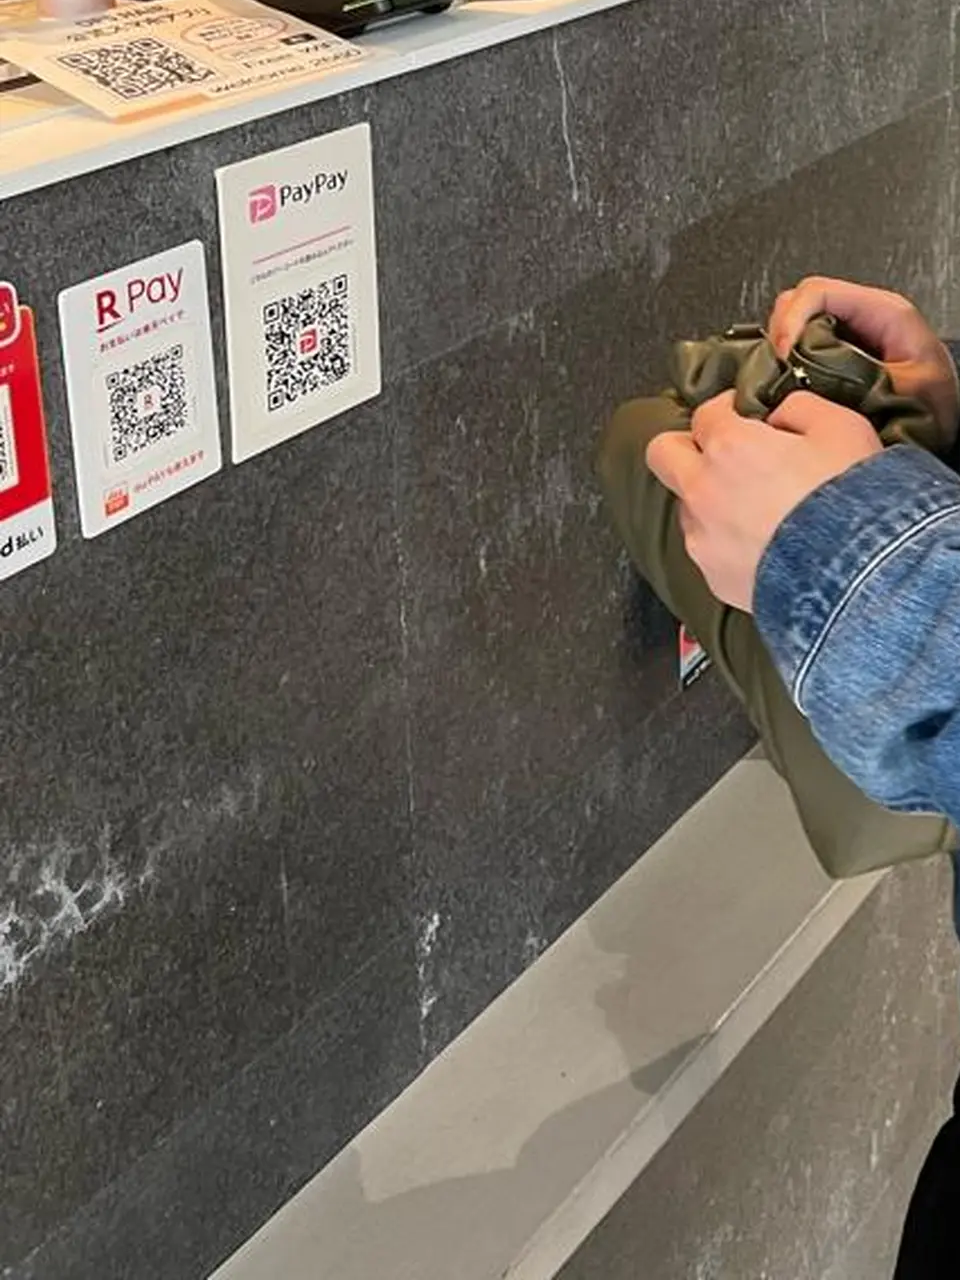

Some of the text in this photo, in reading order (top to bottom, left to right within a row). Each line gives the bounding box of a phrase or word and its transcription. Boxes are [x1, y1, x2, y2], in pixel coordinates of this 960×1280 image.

[279, 169, 348, 207] PayPay
[95, 266, 184, 333] R Pay
